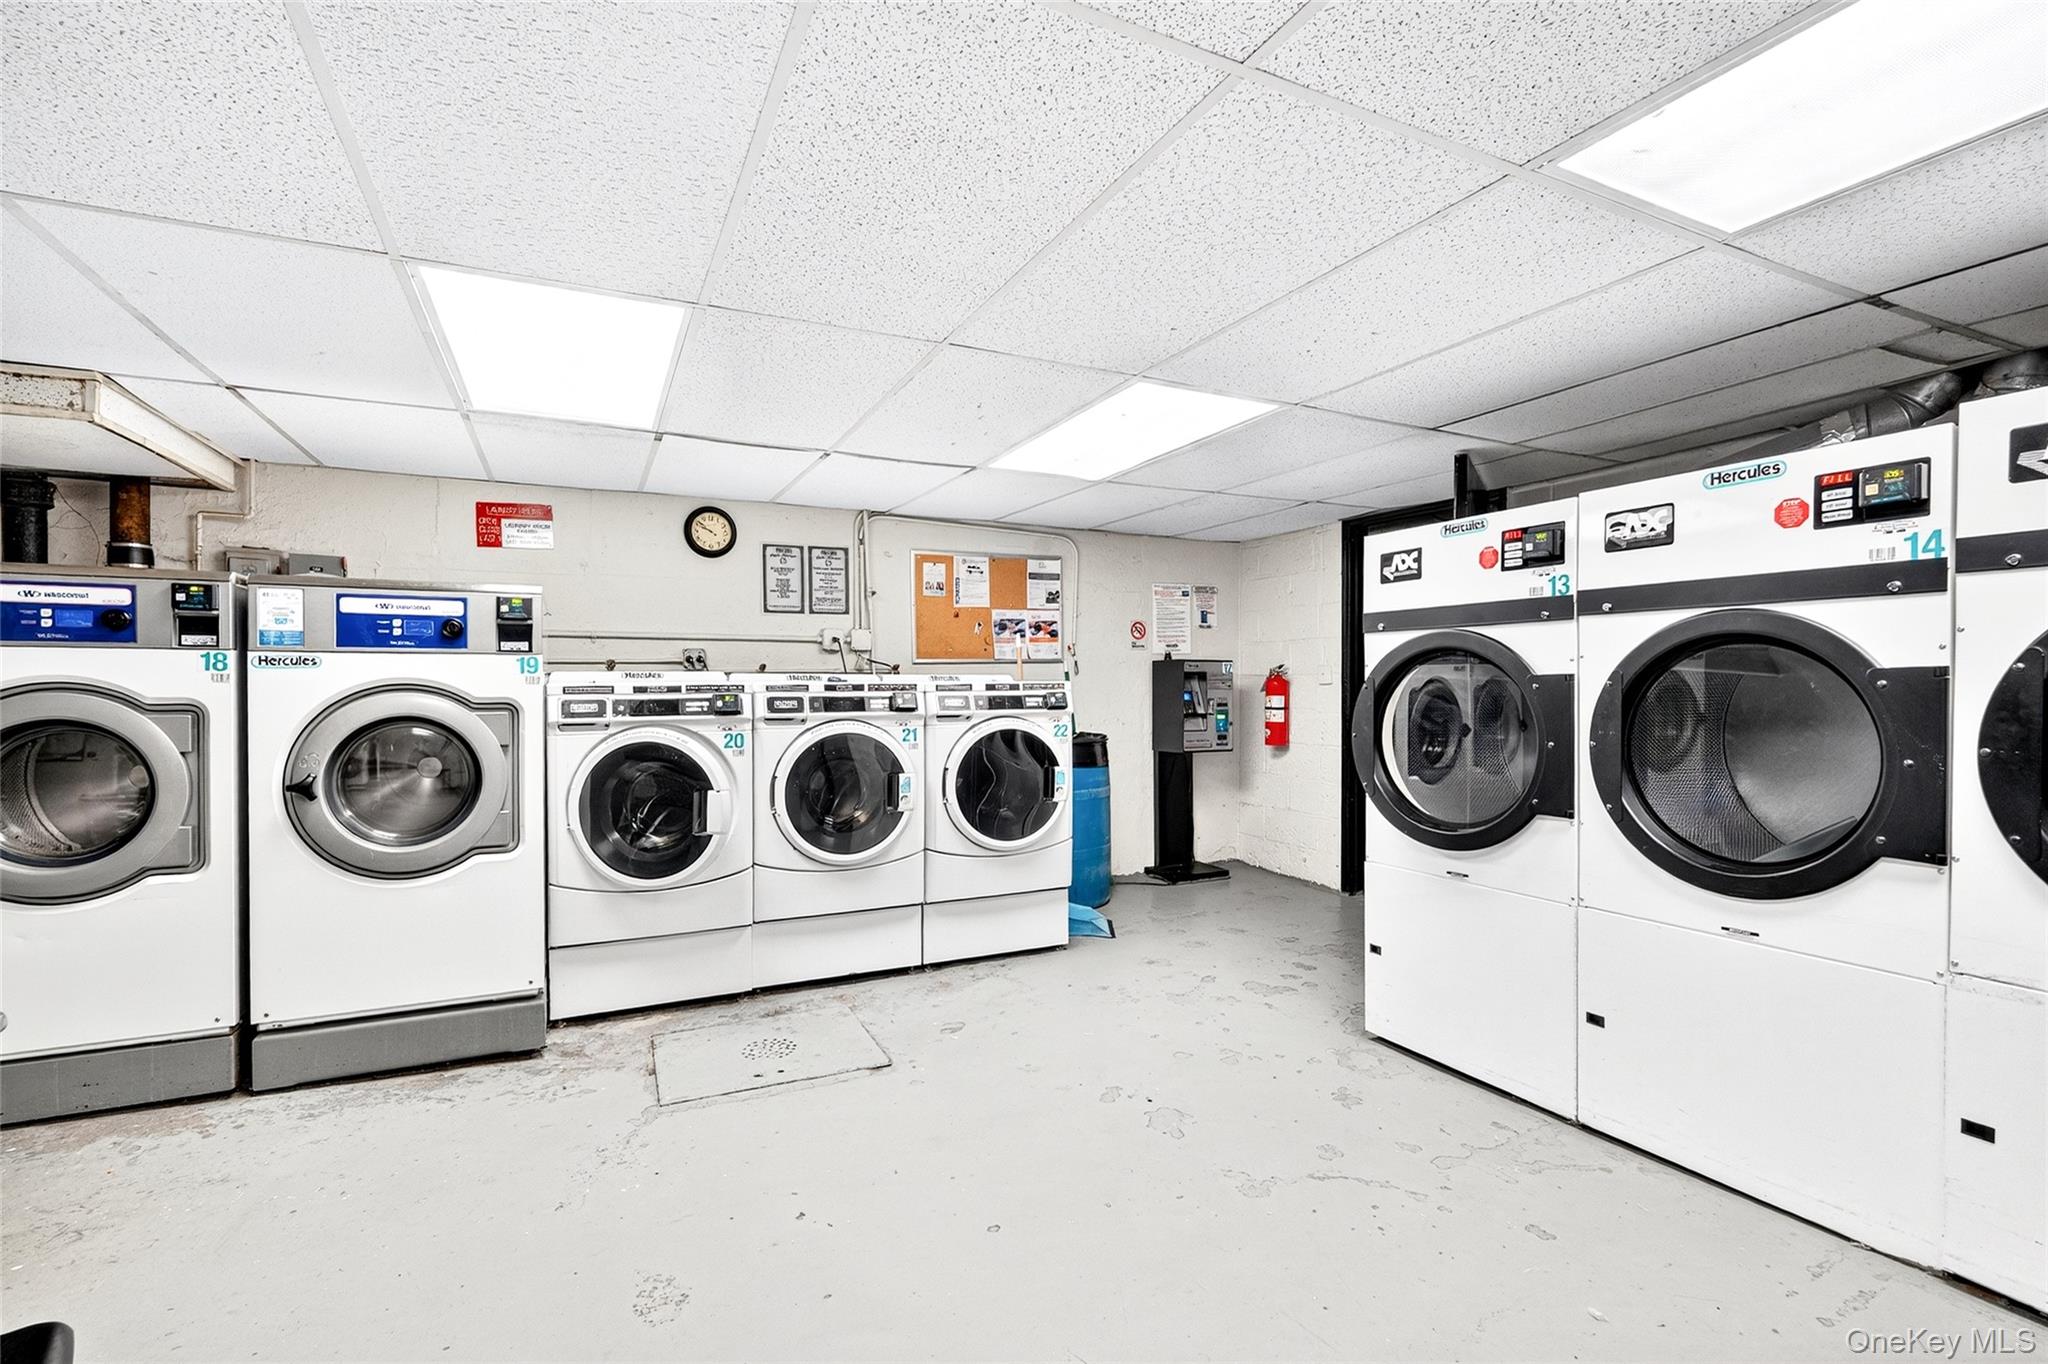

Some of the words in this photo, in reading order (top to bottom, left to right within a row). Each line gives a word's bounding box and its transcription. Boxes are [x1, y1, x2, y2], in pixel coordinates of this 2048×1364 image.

[1710, 463, 1781, 486] Hercules
[1822, 471, 1853, 486] FILL
[1443, 519, 1486, 535] Hercules
[1903, 529, 1946, 560] 14
[1547, 574, 1570, 597] 13
[200, 651, 228, 672] 18
[258, 655, 318, 666] Hercules
[516, 656, 540, 674] 19
[902, 727, 918, 742] 21
[1053, 724, 1068, 738] 22
[723, 732, 745, 750] 20
